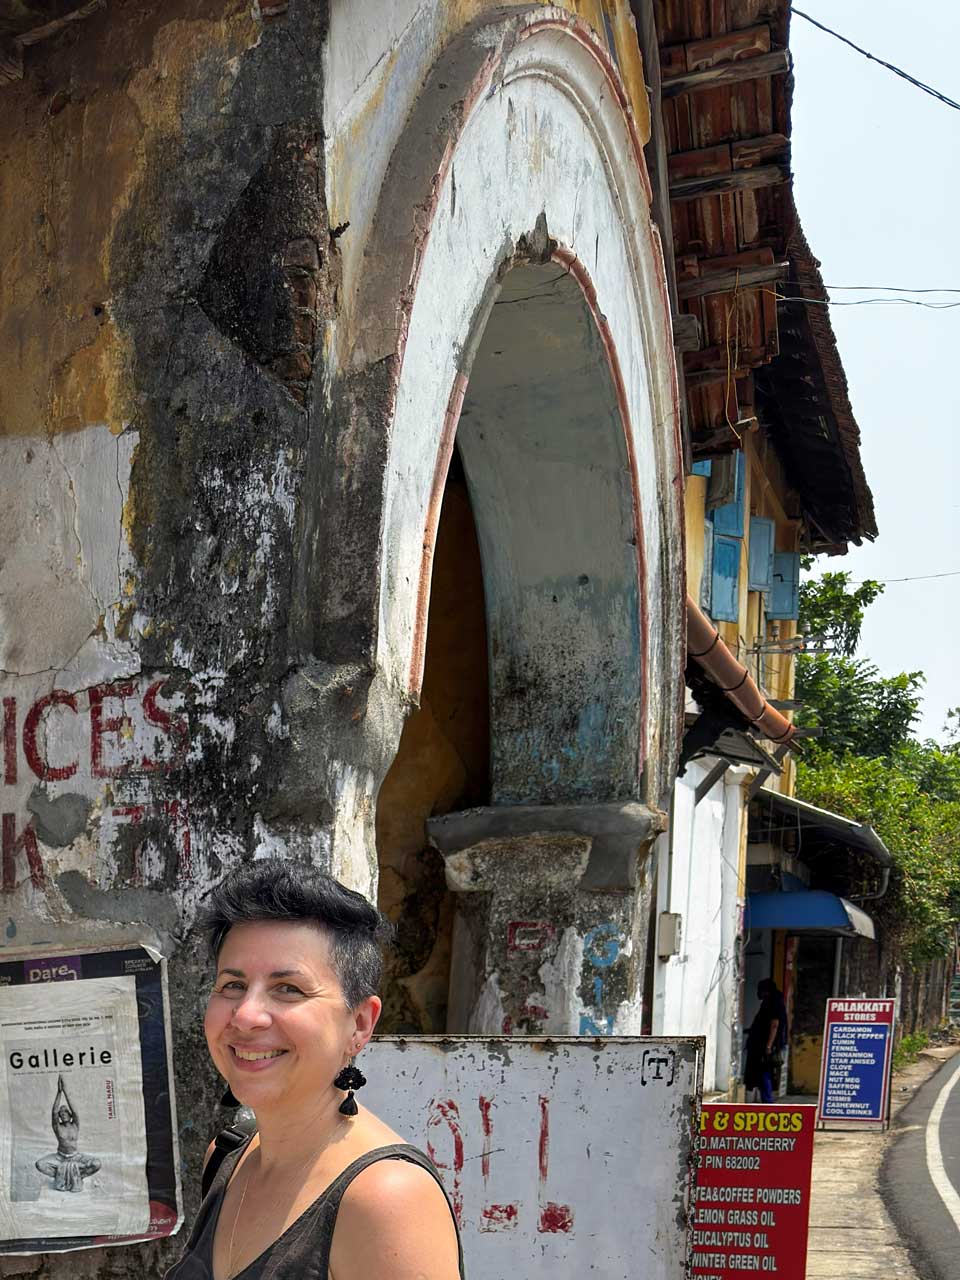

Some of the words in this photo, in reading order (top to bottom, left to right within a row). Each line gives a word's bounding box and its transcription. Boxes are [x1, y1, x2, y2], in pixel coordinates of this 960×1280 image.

[30, 965, 68, 982] Dare
[831, 1002, 892, 1012] PALAKKATT
[843, 1013, 876, 1021] STORES
[9, 1046, 113, 1069] Gallerie
[713, 1112, 730, 1131] &
[733, 1112, 803, 1132] SPICES
[705, 1155, 723, 1169] PIN
[725, 1156, 760, 1170] 682002
[756, 1188, 801, 1205] POWDERS
[727, 1209, 758, 1226] GRASS
[760, 1211, 776, 1227] OIL
[693, 1230, 752, 1248] EUCALYPTUS
[753, 1233, 769, 1249] OIL
[692, 1252, 726, 1269] WINTER
[728, 1254, 760, 1271] GREEN
[761, 1256, 778, 1272] OIL
